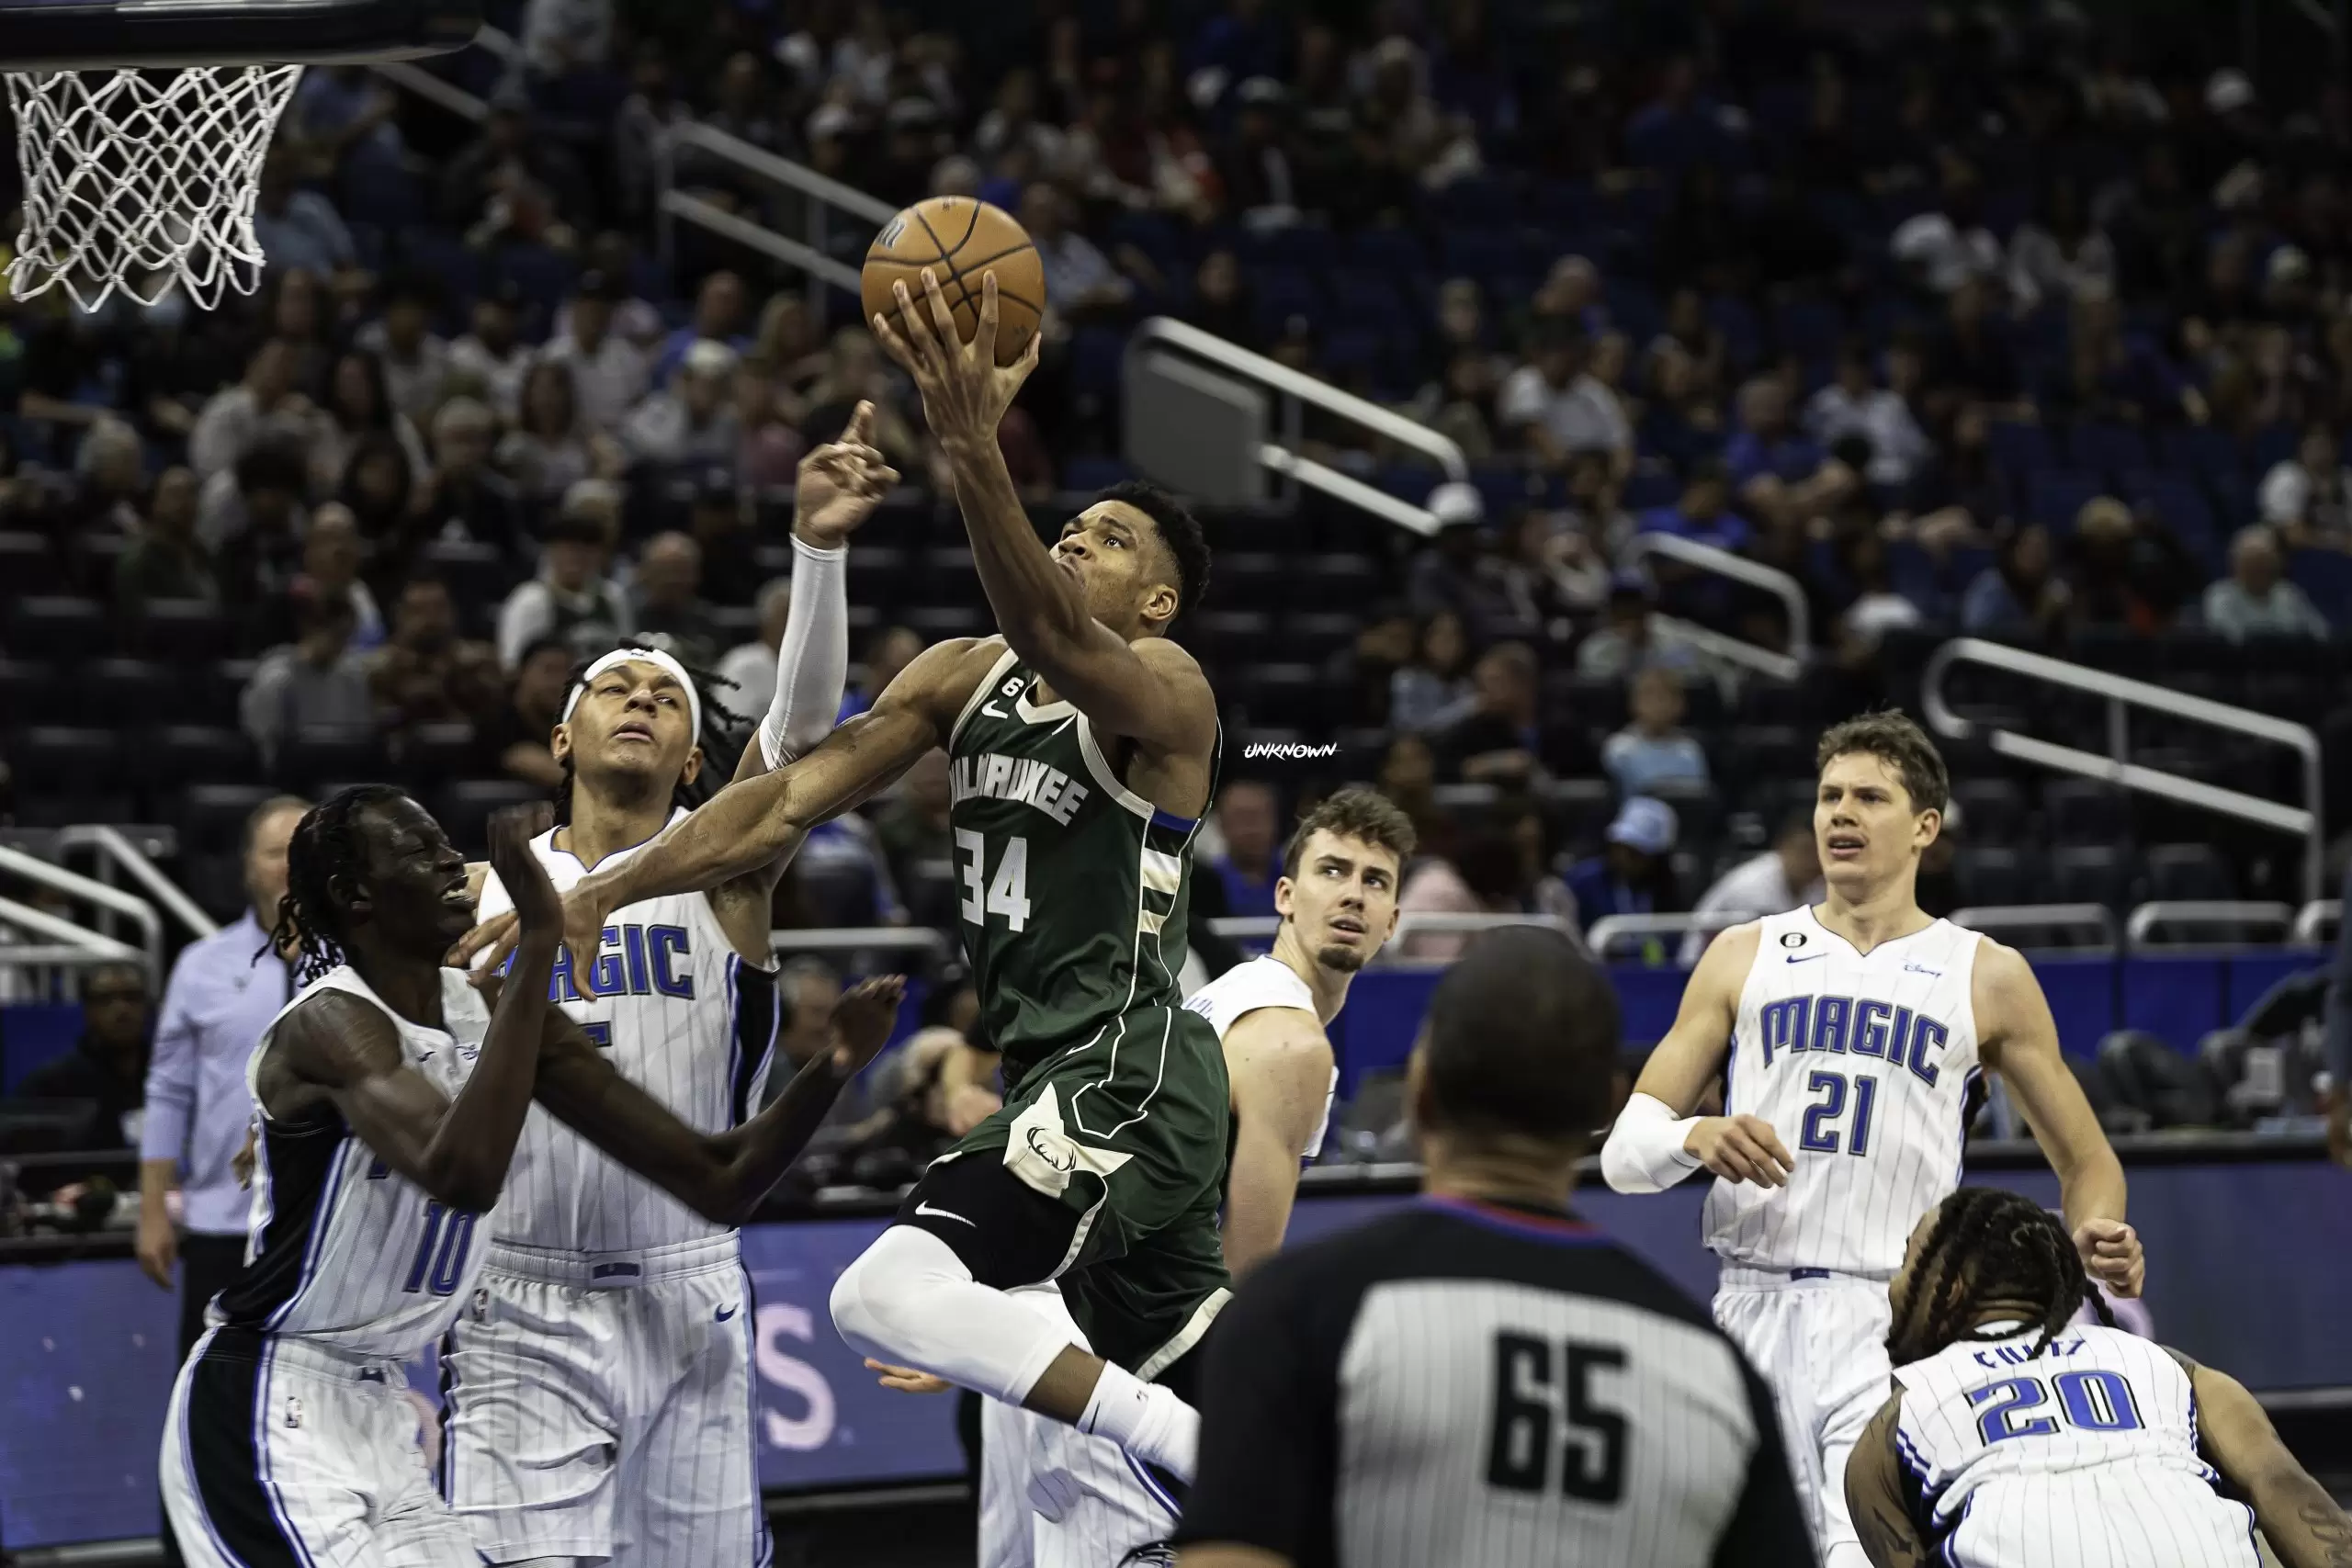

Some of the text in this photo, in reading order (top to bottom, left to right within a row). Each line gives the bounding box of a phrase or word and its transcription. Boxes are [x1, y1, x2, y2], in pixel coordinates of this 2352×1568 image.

[1001, 676, 1024, 697] 6
[955, 827, 1031, 932] 34
[492, 923, 695, 1000] AGIC
[1759, 994, 1950, 1089] MAGIC
[1799, 1070, 1878, 1157] 21
[401, 1198, 480, 1297] 10
[1486, 1328, 1632, 1506] 65
[1962, 1371, 2146, 1448] 20
